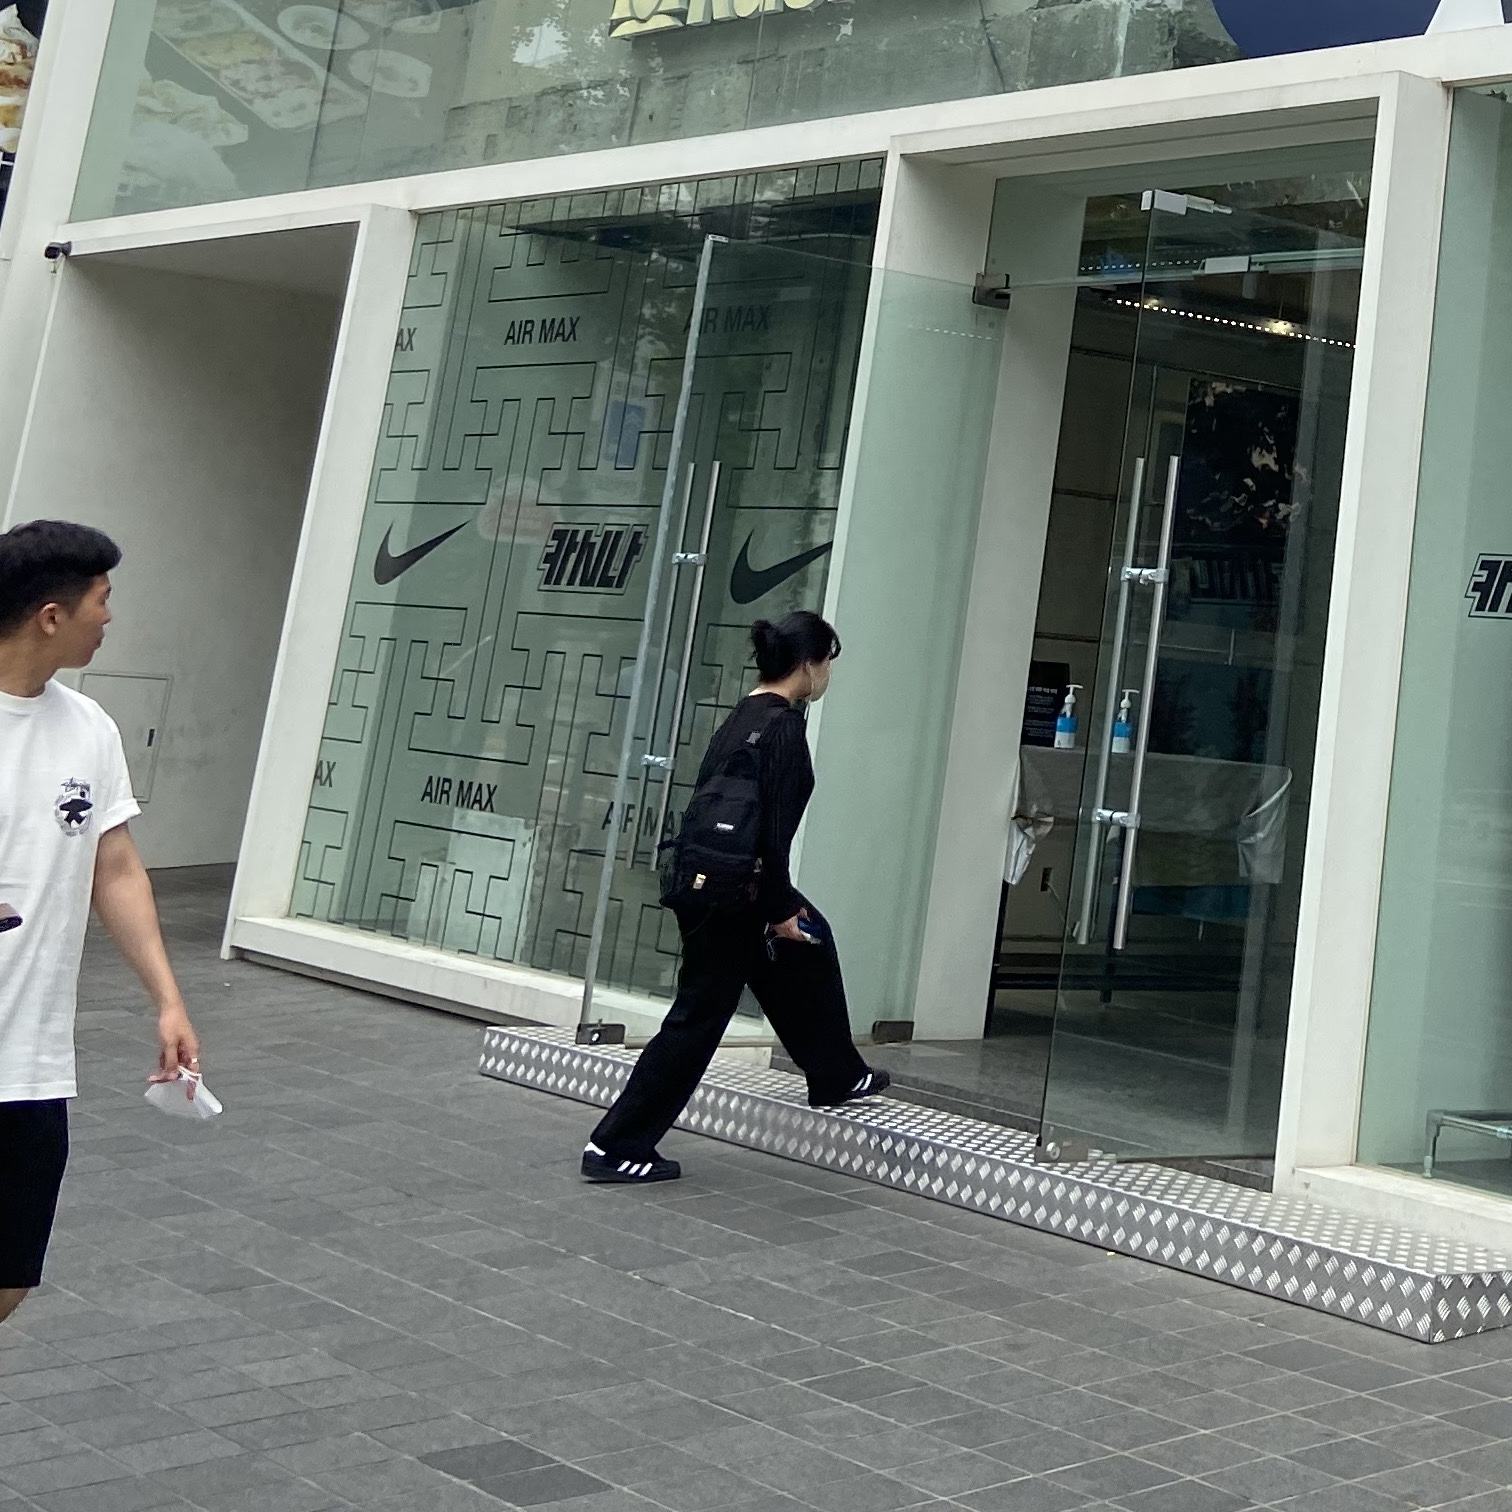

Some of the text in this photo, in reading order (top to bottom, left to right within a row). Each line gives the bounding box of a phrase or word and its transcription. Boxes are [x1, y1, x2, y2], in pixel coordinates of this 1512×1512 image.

[504, 316, 580, 345] AIR MAX
[724, 304, 771, 333] MAX
[420, 775, 498, 813] AIR MAX
